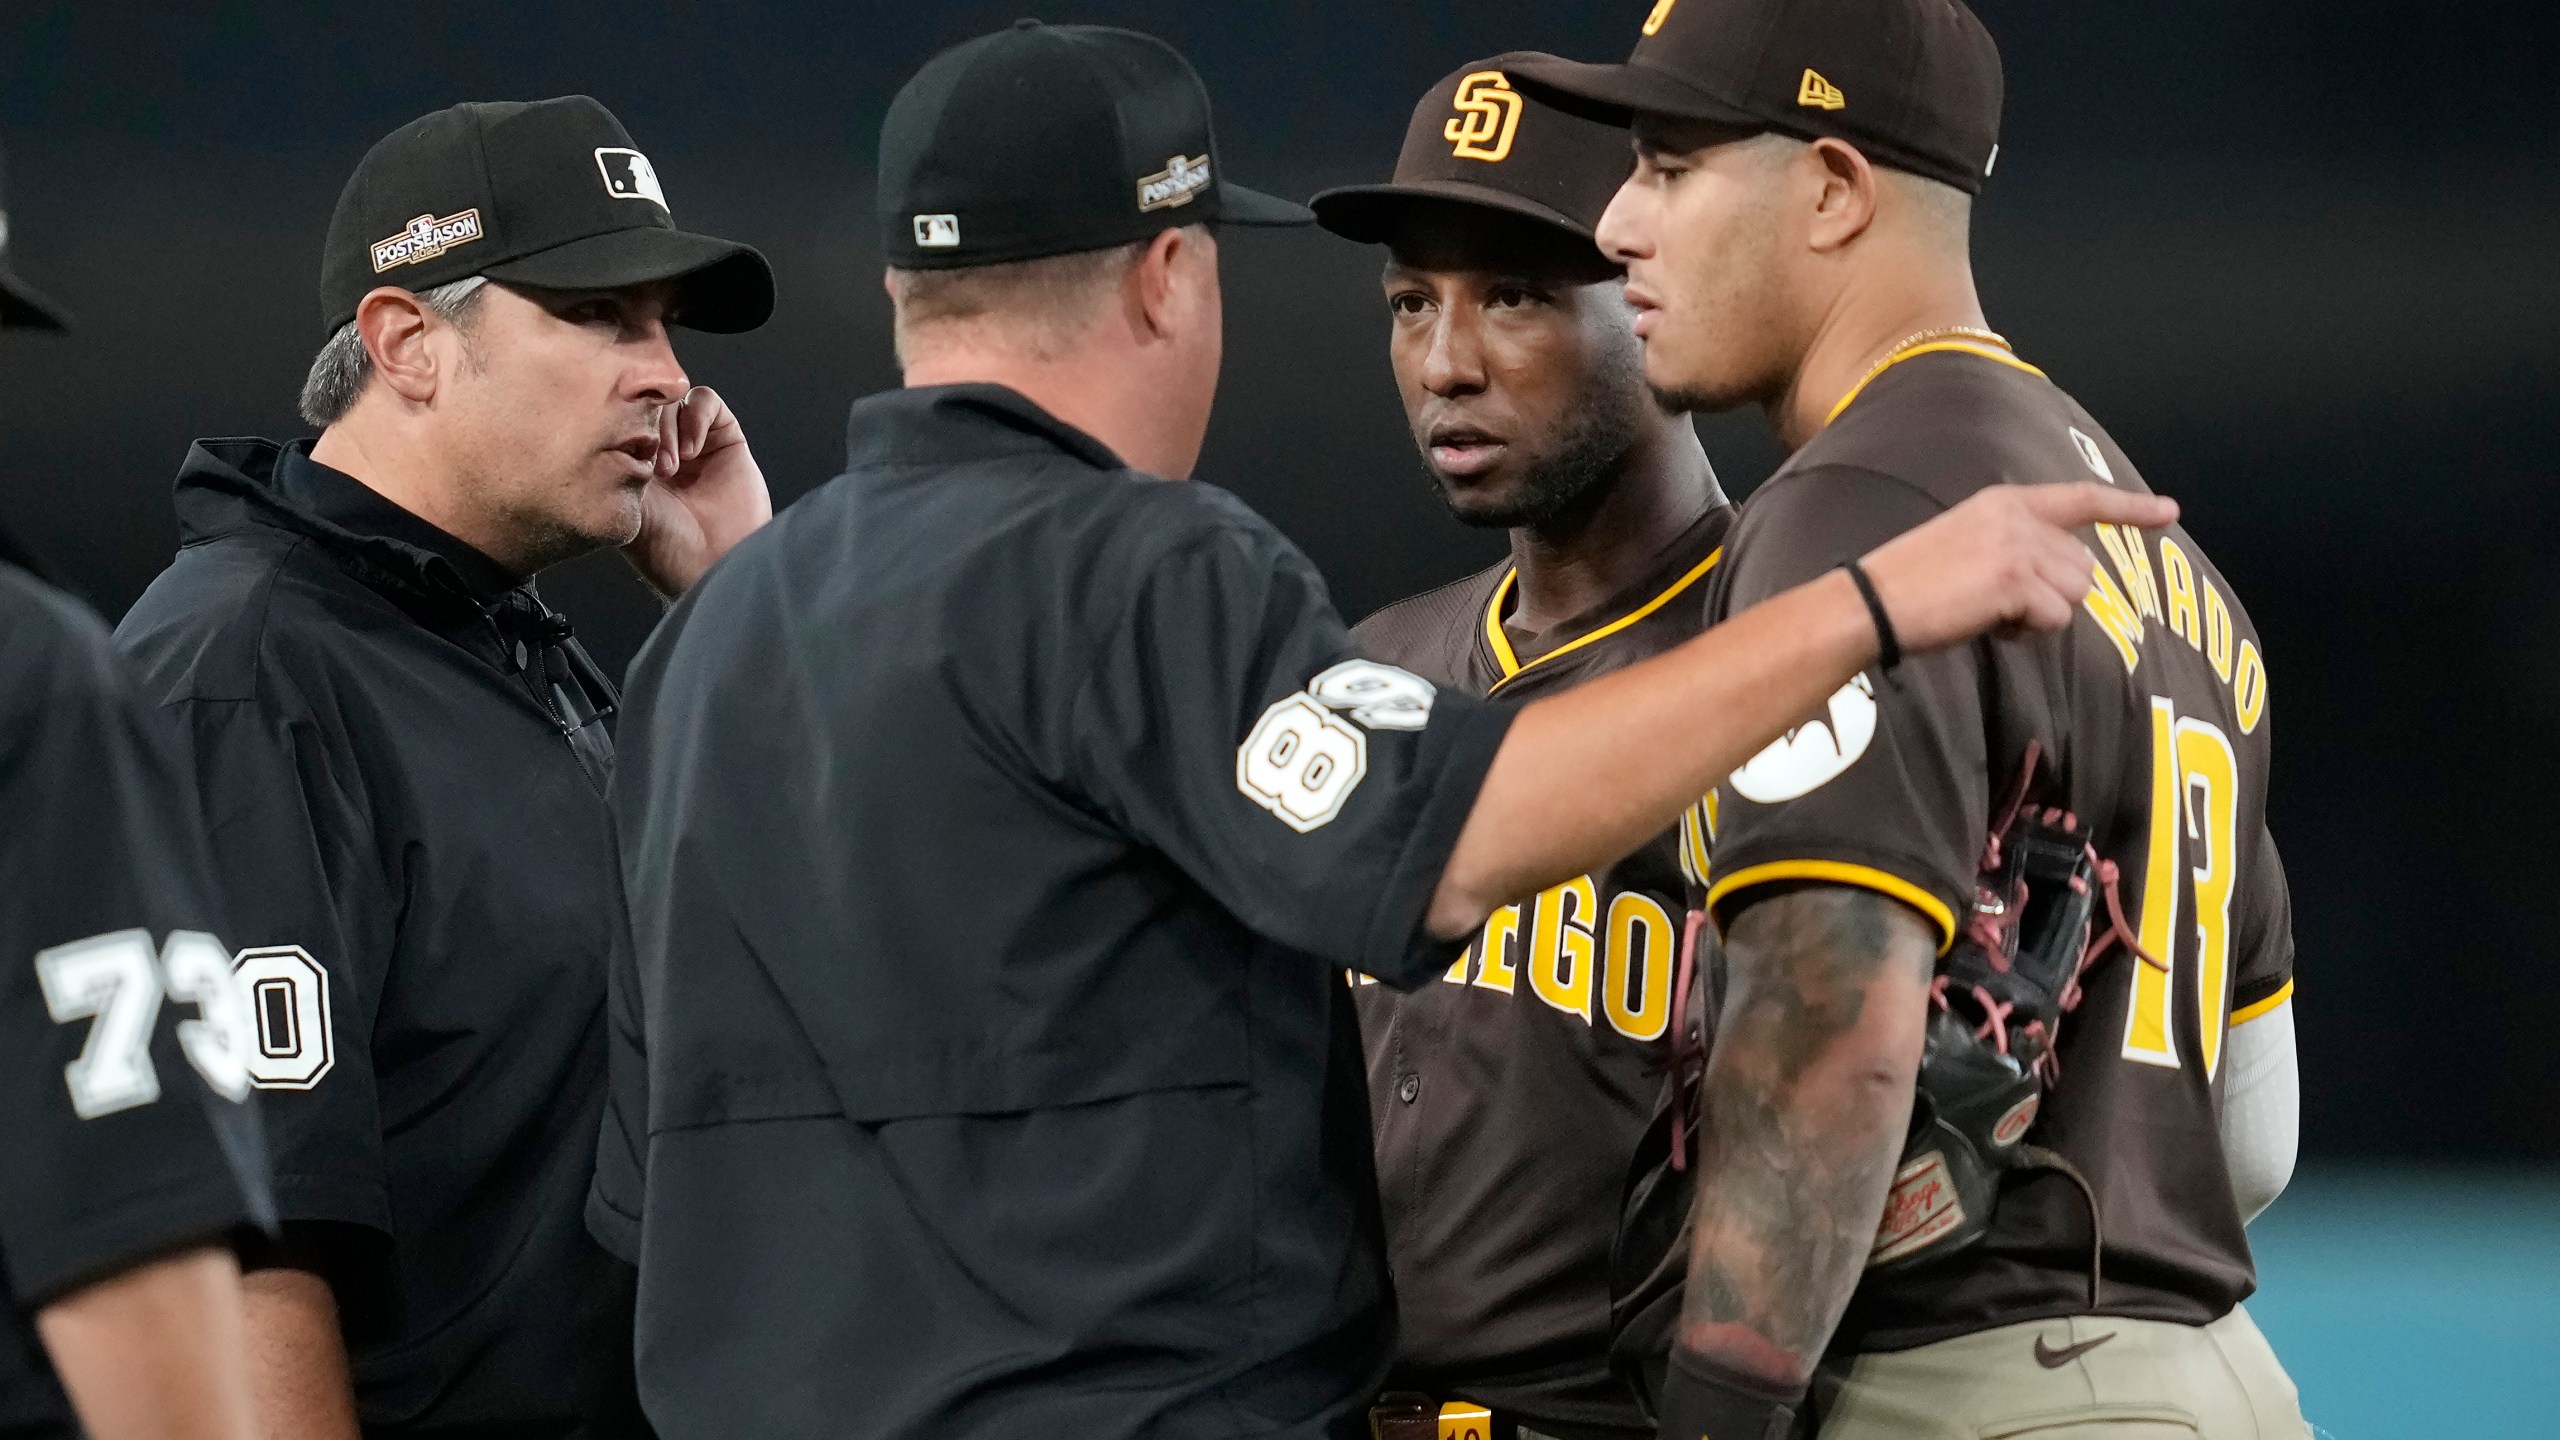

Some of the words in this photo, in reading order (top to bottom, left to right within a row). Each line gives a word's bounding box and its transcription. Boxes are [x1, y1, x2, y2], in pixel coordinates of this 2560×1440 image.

[1443, 70, 1524, 163] SD
[375, 216, 478, 267] POSTSEASON
[411, 244, 442, 261] 2024
[2121, 694, 2239, 1085] 13
[34, 926, 252, 1122] 73
